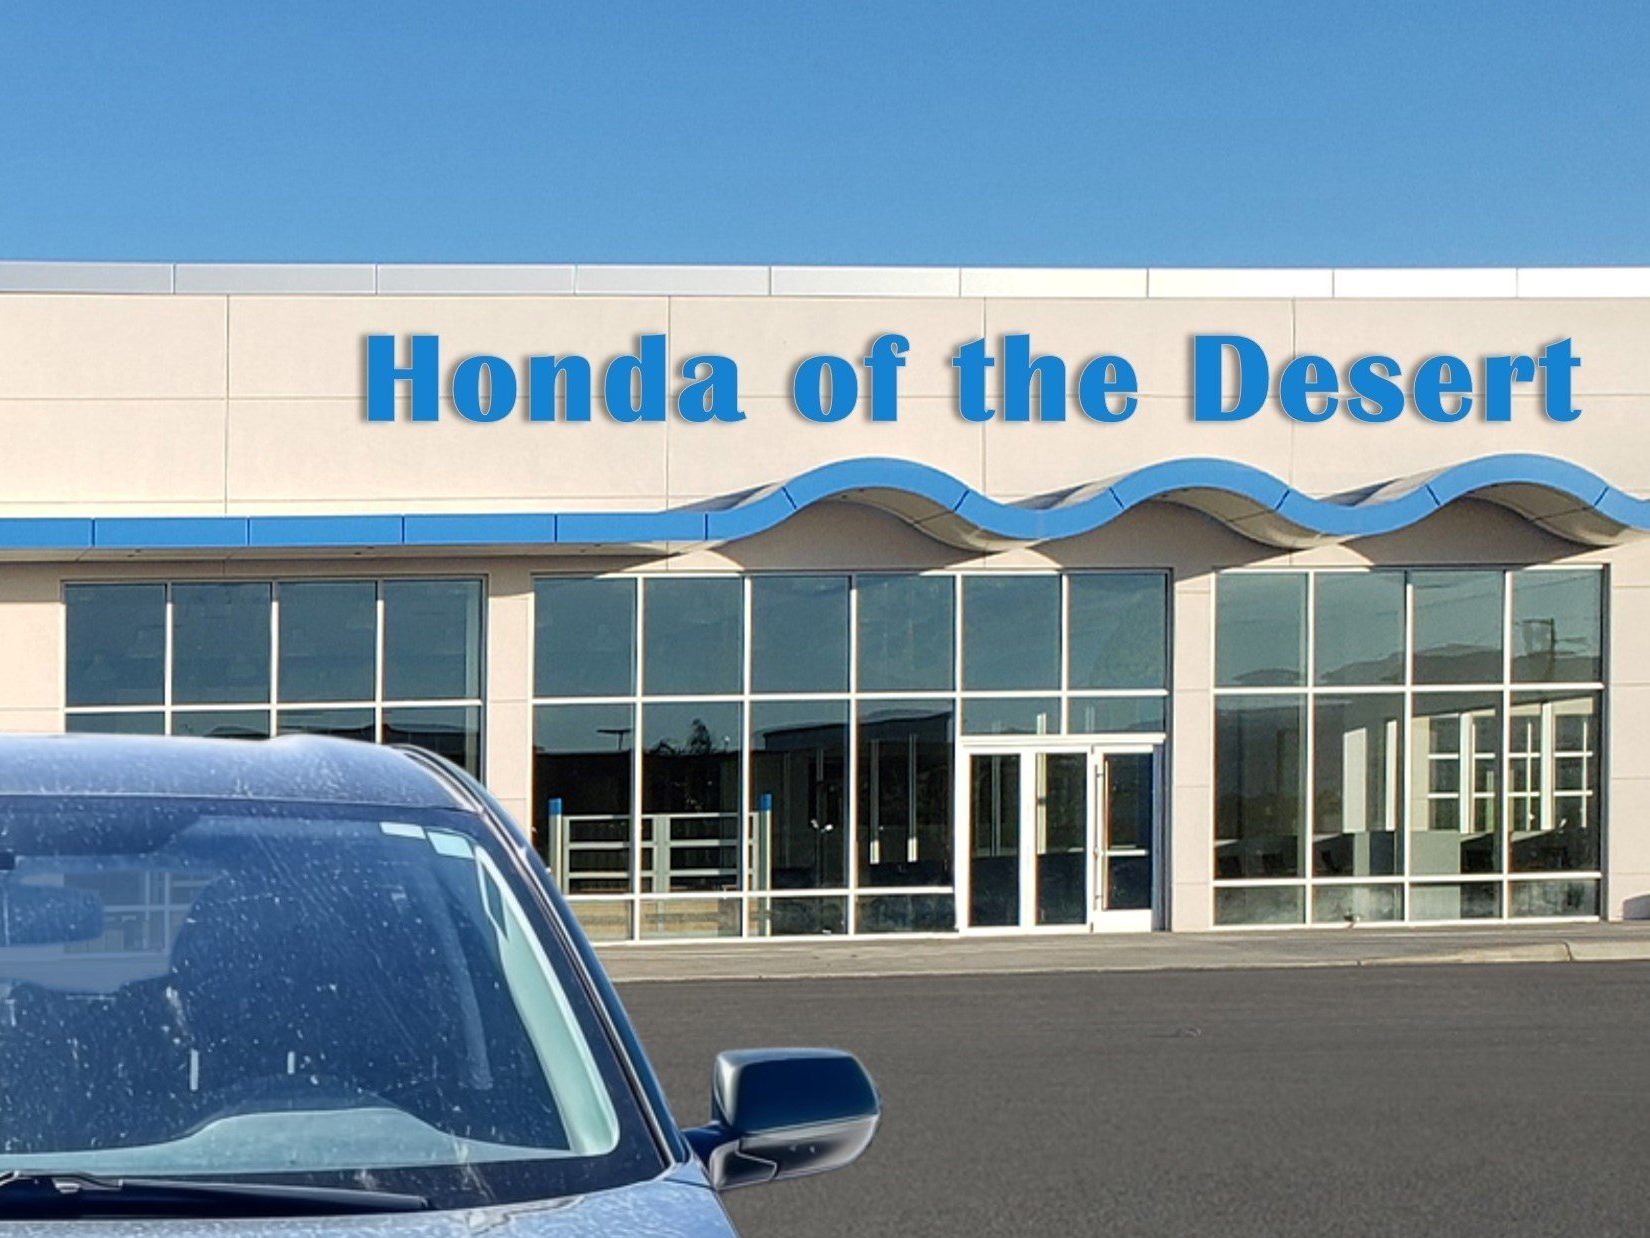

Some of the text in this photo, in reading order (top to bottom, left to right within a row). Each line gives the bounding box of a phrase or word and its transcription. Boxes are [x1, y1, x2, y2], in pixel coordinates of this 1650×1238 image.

[366, 333, 1581, 424] Honda of the Desert
